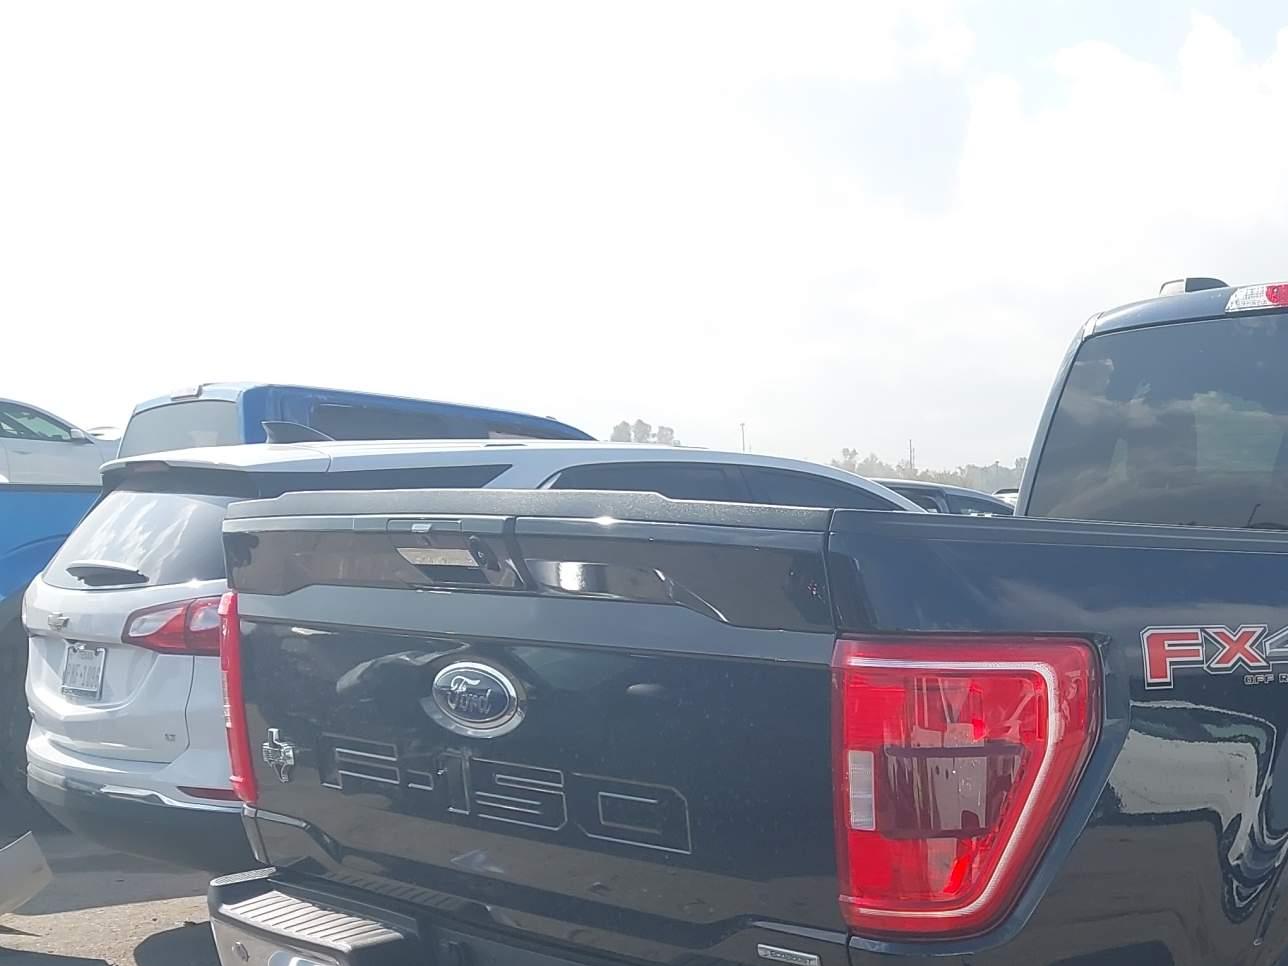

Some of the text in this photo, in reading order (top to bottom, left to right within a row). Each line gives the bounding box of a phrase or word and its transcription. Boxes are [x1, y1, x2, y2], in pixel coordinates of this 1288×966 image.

[447, 674, 493, 715] Ford
[1243, 674, 1275, 685] OFF
[320, 731, 692, 855] F-150
